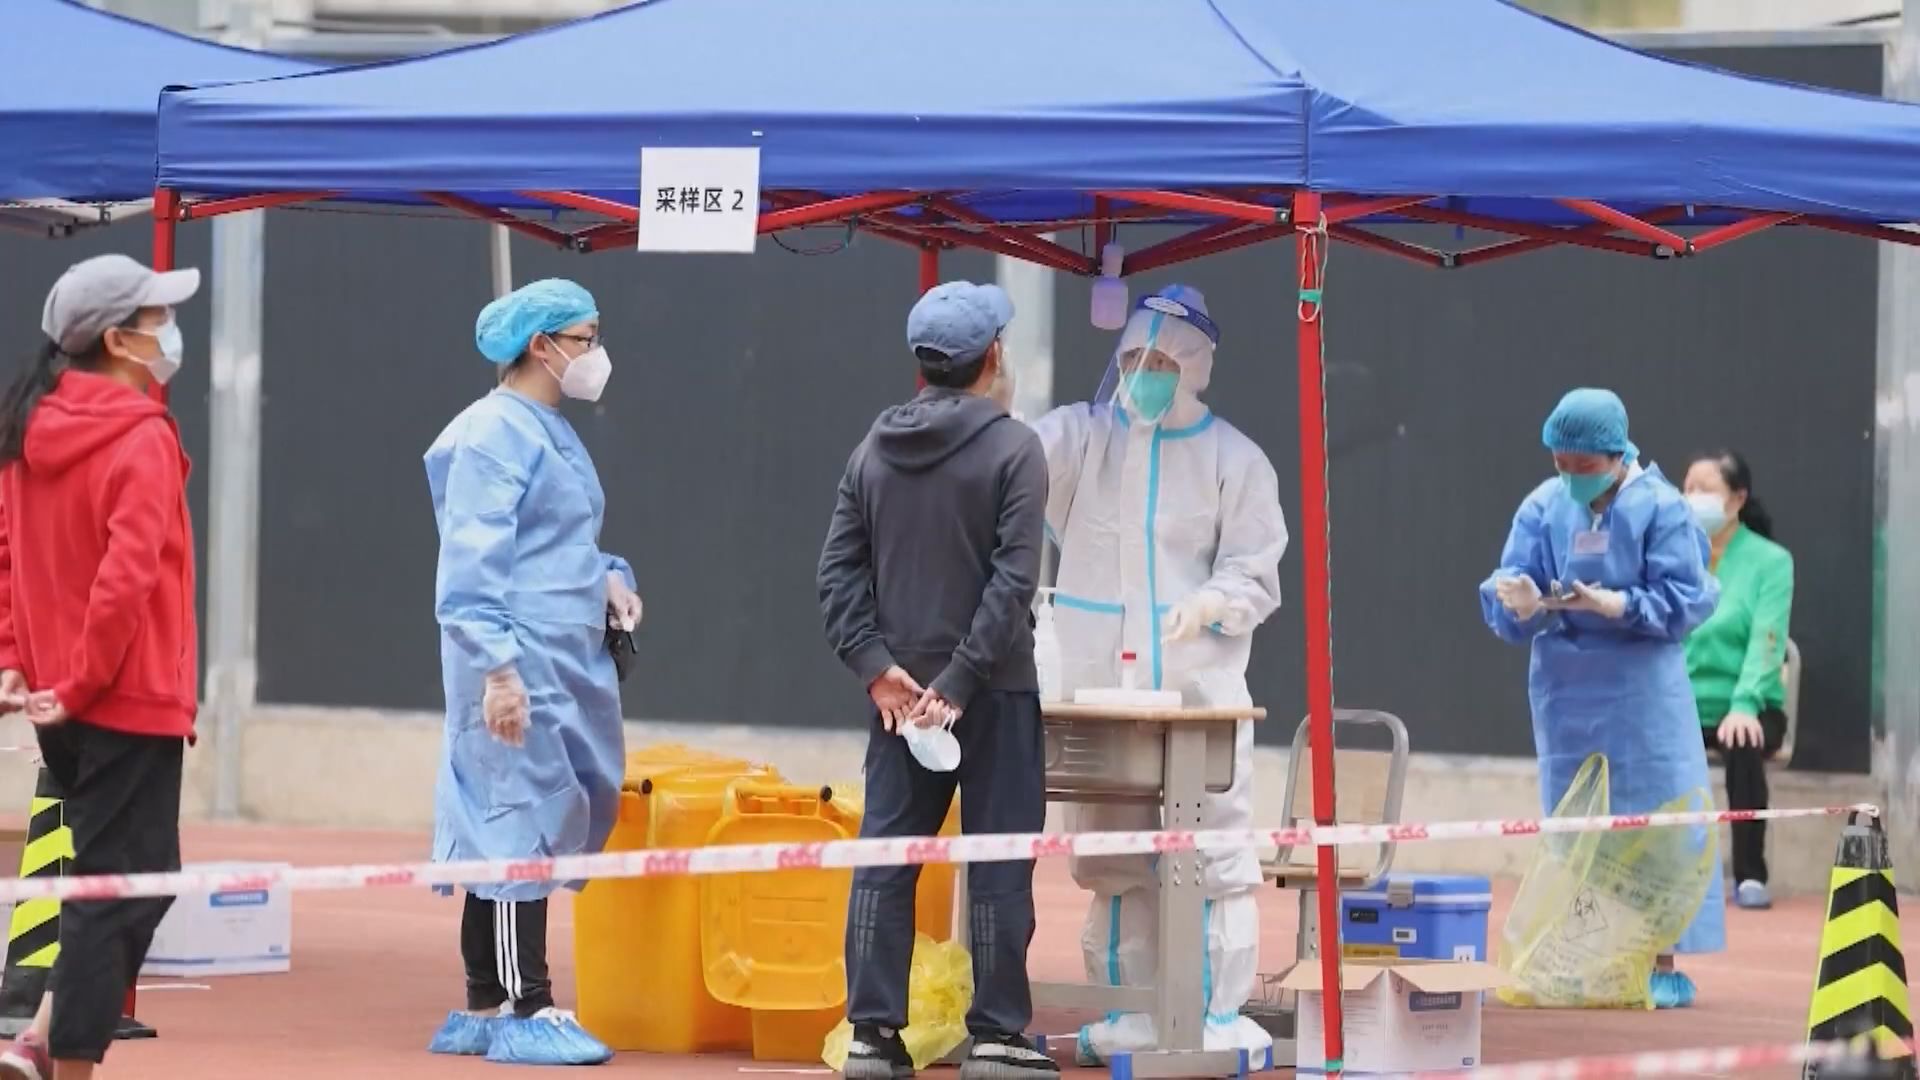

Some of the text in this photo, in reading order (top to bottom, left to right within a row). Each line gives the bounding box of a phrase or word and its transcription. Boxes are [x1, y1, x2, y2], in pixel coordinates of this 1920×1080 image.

[656, 187, 744, 214] 采样区 2
